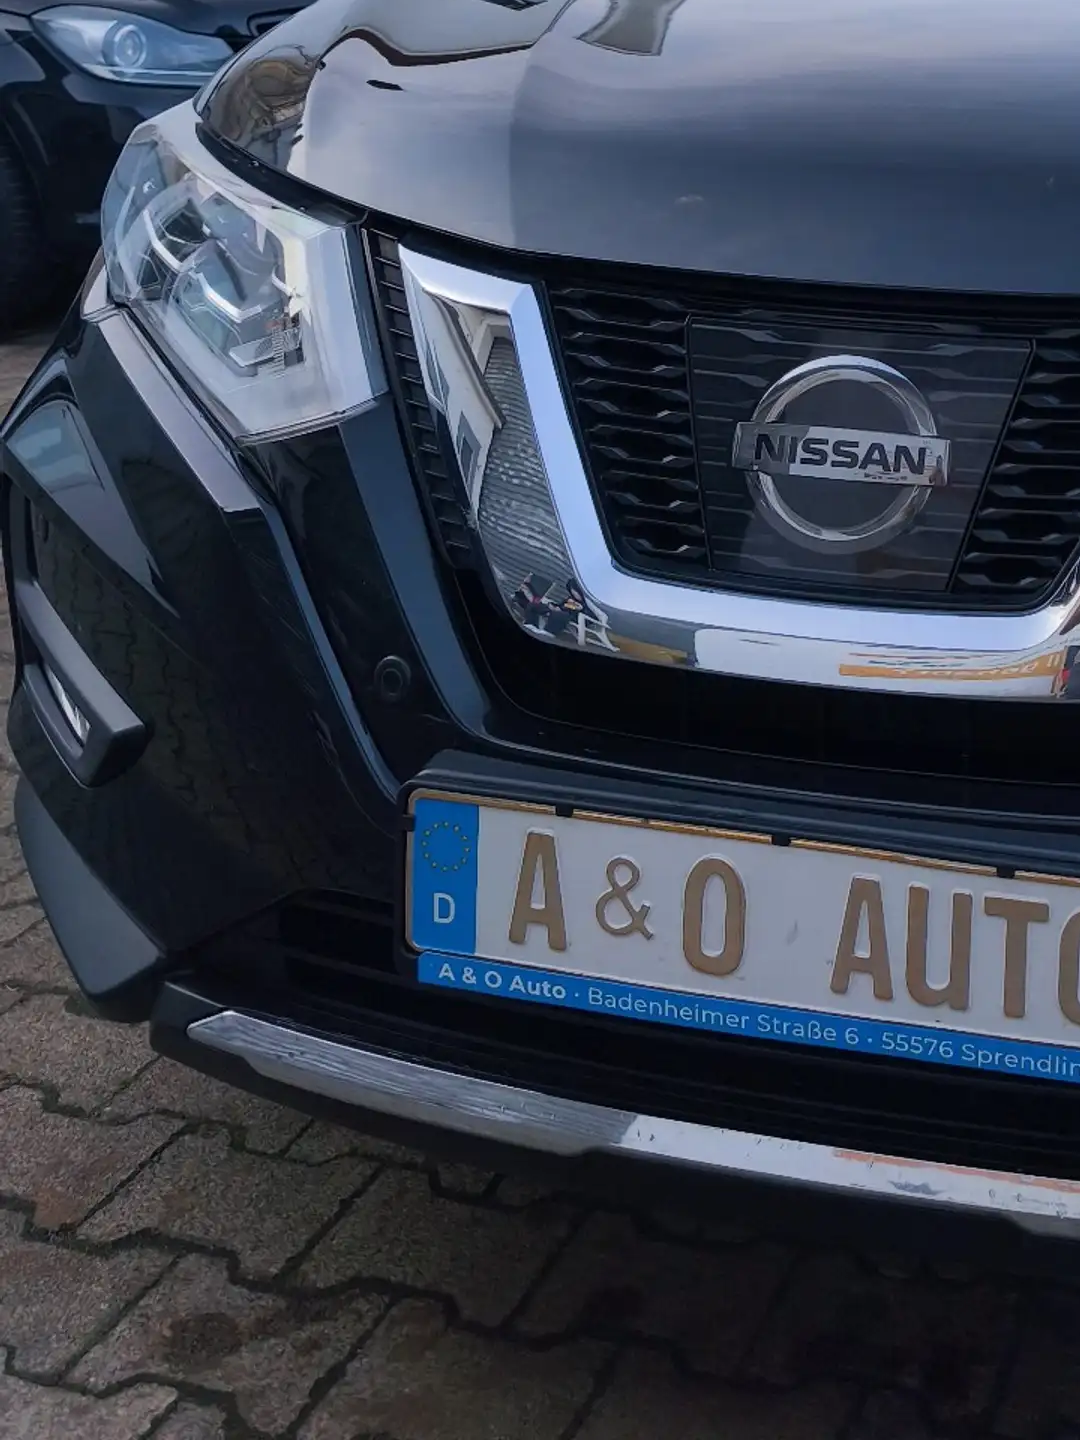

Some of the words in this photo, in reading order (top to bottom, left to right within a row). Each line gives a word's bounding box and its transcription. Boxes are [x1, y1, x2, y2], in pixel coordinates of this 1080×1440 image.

[754, 433, 927, 475] NISSAN
[432, 892, 456, 924] D
[508, 827, 567, 951] A
[594, 854, 655, 941] &
[682, 853, 747, 976] O
[438, 962, 456, 981] A
[462, 967, 478, 985] &
[484, 970, 503, 989] O
[509, 975, 567, 1001] Auto
[588, 987, 750, 1030] Badenheimer
[757, 1013, 837, 1042] Straße
[844, 1026, 859, 1045] 6
[882, 1032, 954, 1059] 55576
